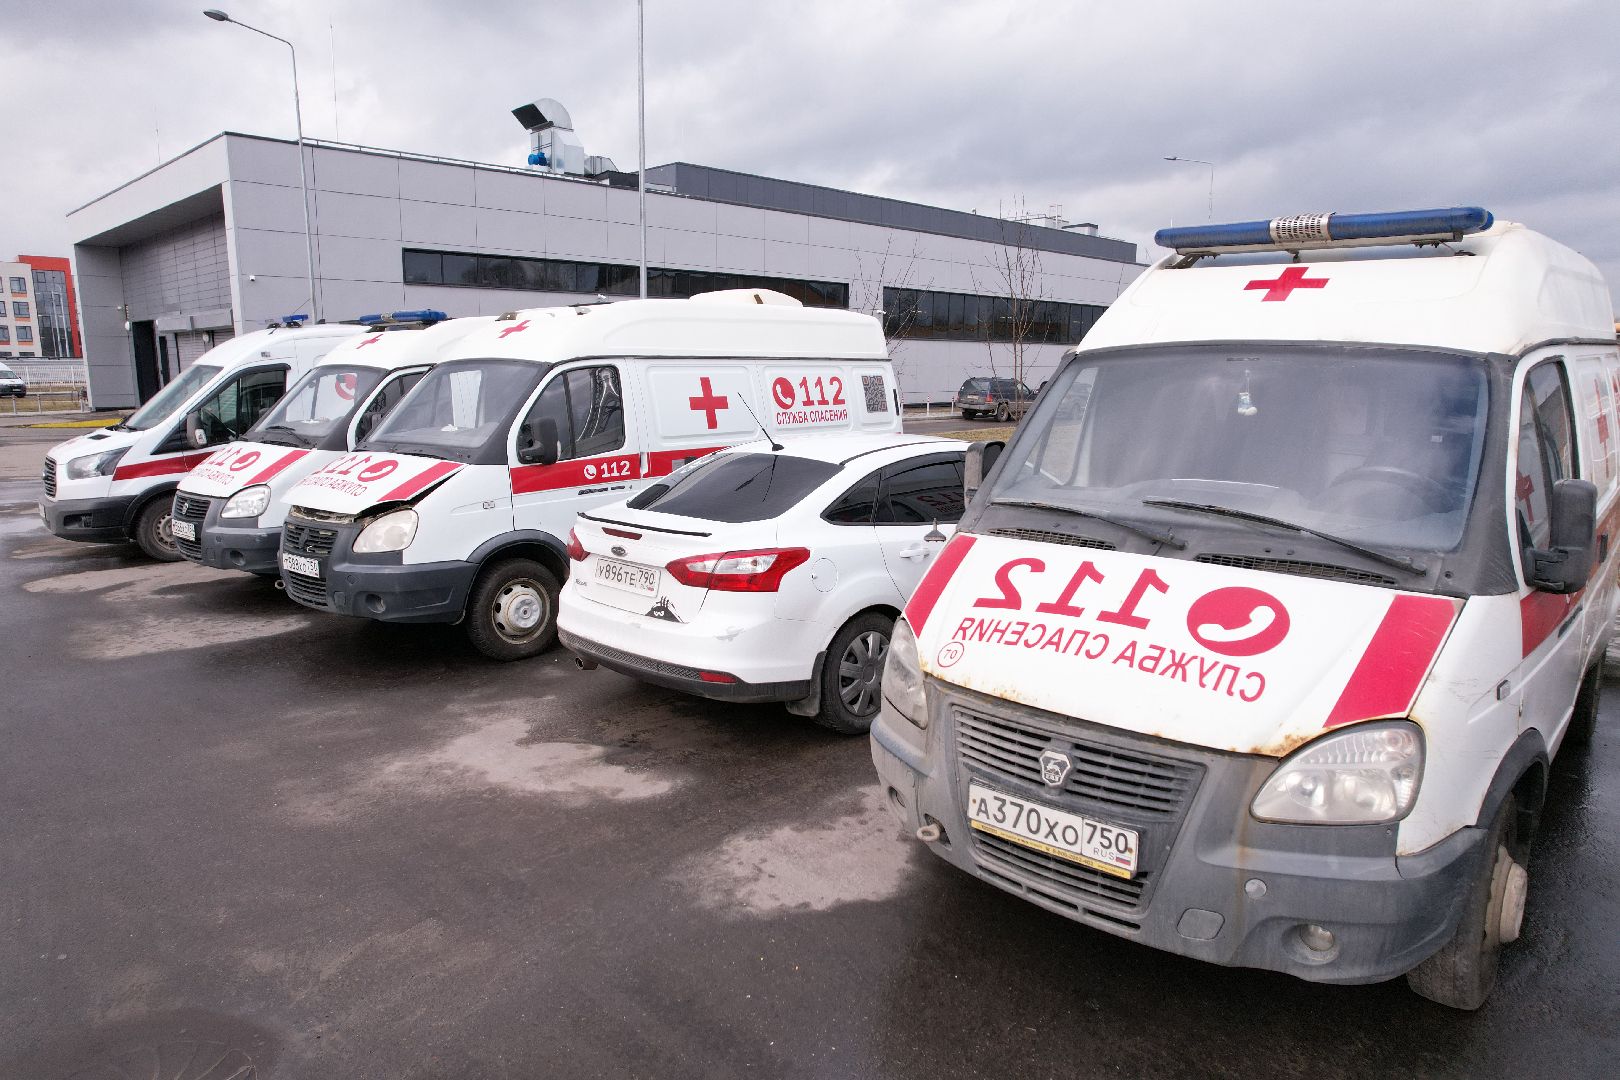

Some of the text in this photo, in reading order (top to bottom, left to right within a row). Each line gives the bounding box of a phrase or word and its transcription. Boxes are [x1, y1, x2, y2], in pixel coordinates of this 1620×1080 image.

[799, 376, 845, 406] 112
[776, 408, 848, 425] СЛУЖБА СПАСЕНИЯ
[600, 460, 630, 478] 112
[1085, 822, 1129, 854] 750
[1093, 847, 1116, 861] RUS
